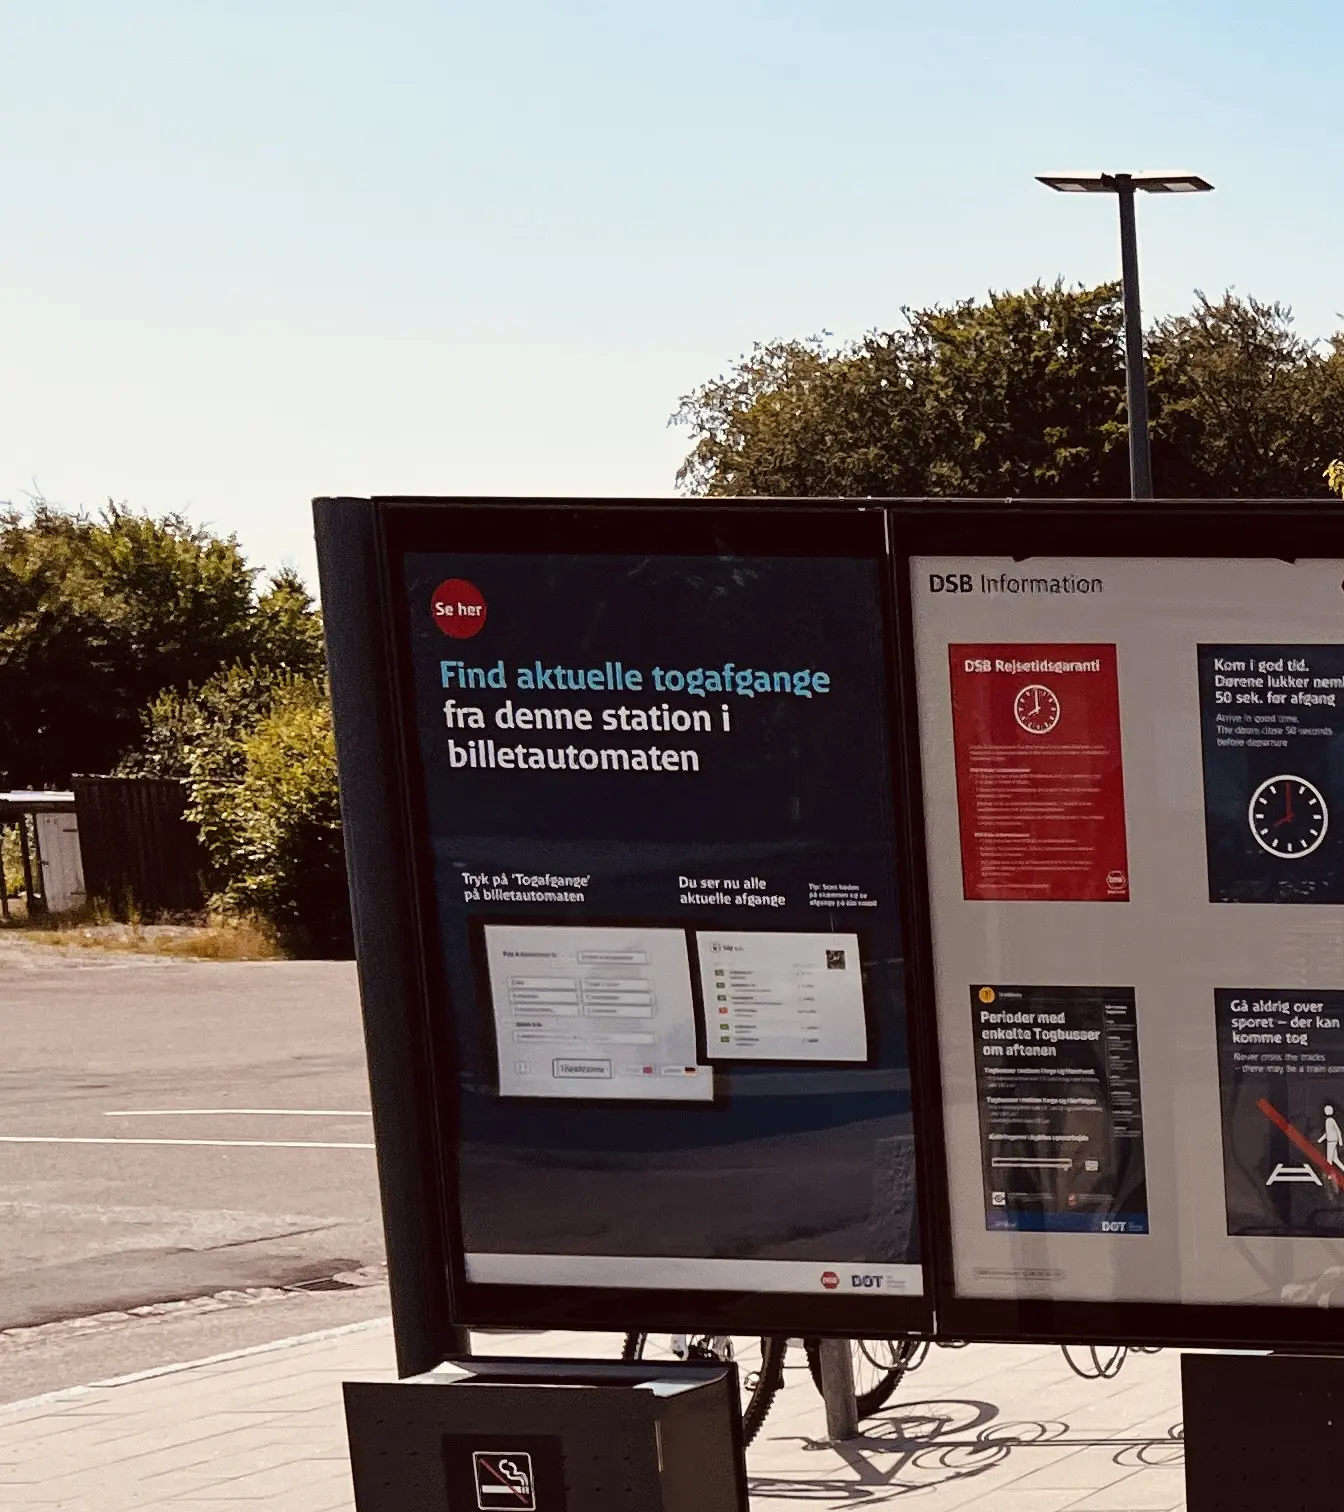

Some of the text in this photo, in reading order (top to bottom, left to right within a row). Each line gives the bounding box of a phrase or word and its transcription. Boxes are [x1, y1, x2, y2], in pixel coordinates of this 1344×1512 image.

[929, 574, 1102, 594] DSB Information
[435, 601, 483, 617] Se her
[965, 659, 1100, 674] DSB Rejsetidsgaranti
[1214, 658, 1245, 671] Kom
[1259, 659, 1283, 673] god
[1287, 659, 1309, 672] tid.
[440, 661, 830, 698] Find aktuelle togafgange
[1215, 675, 1263, 688] Dørene
[1268, 676, 1309, 688] lukker
[1216, 691, 1336, 707] 50 sek. før afgang
[443, 700, 730, 732] fra denne station i
[448, 739, 699, 772] billetautomaten
[462, 873, 491, 888] Tryk
[493, 873, 507, 889] på
[679, 877, 766, 891] Du ser nu alle
[464, 888, 585, 904] på billetautomaten
[680, 892, 785, 908] aktuelle afgange
[1231, 1000, 1323, 1014] Gå aldrig over
[980, 1010, 1065, 1024] Perioder med
[1231, 1017, 1274, 1030] sporet
[1290, 1016, 1312, 1028] der
[1316, 1016, 1340, 1028] kan
[981, 1028, 1101, 1042] enkelte Togbusser
[1232, 1032, 1308, 1045] komme tog
[983, 1044, 1056, 1056] om aftenen
[852, 1275, 883, 1288] DOT
